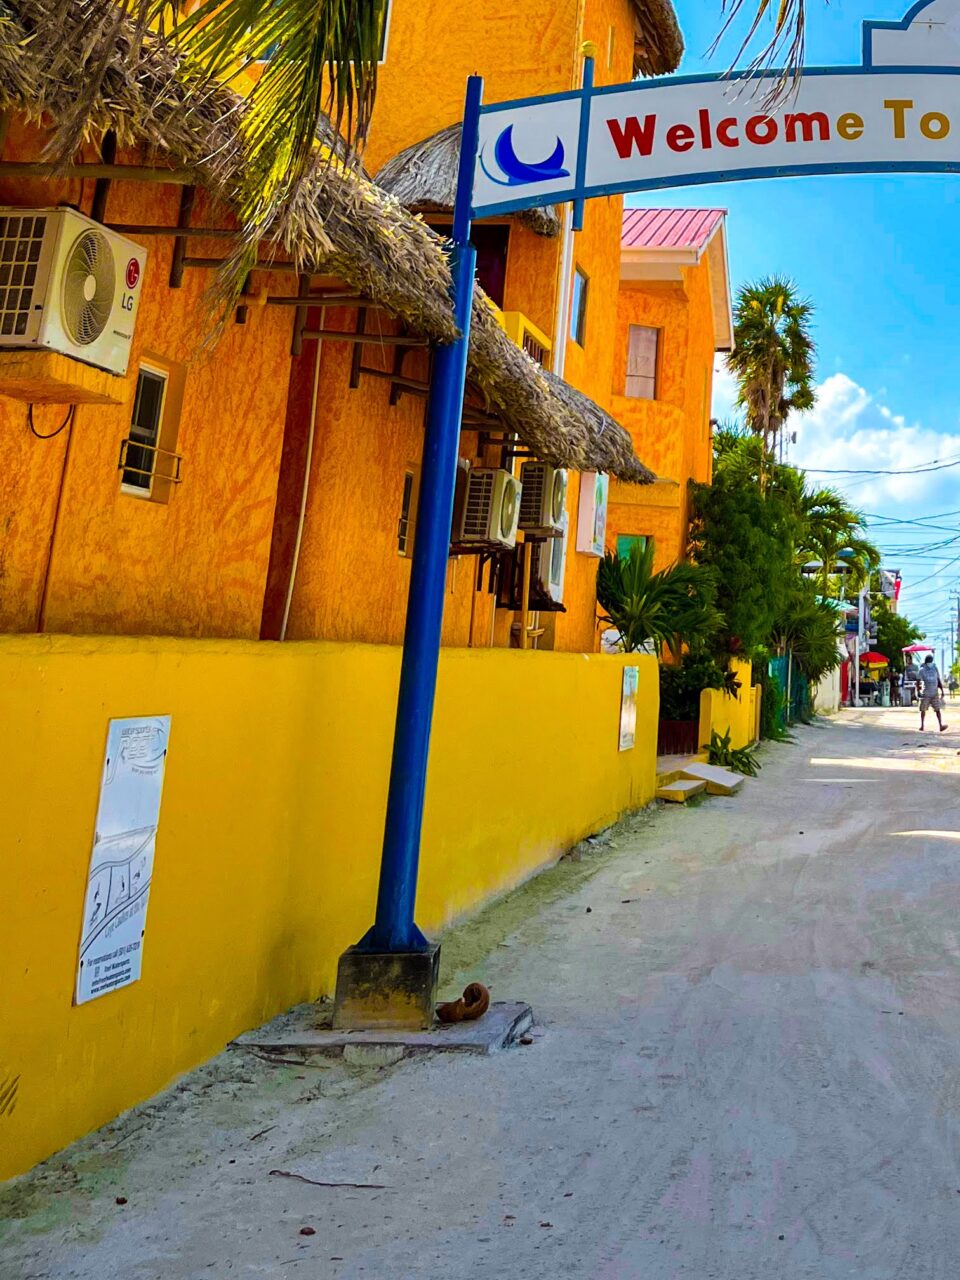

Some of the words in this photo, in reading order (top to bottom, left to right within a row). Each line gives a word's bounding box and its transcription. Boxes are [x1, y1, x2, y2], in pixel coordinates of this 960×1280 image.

[606, 108, 865, 159] Welcome
[884, 100, 951, 140] To
[121, 292, 134, 311] LG
